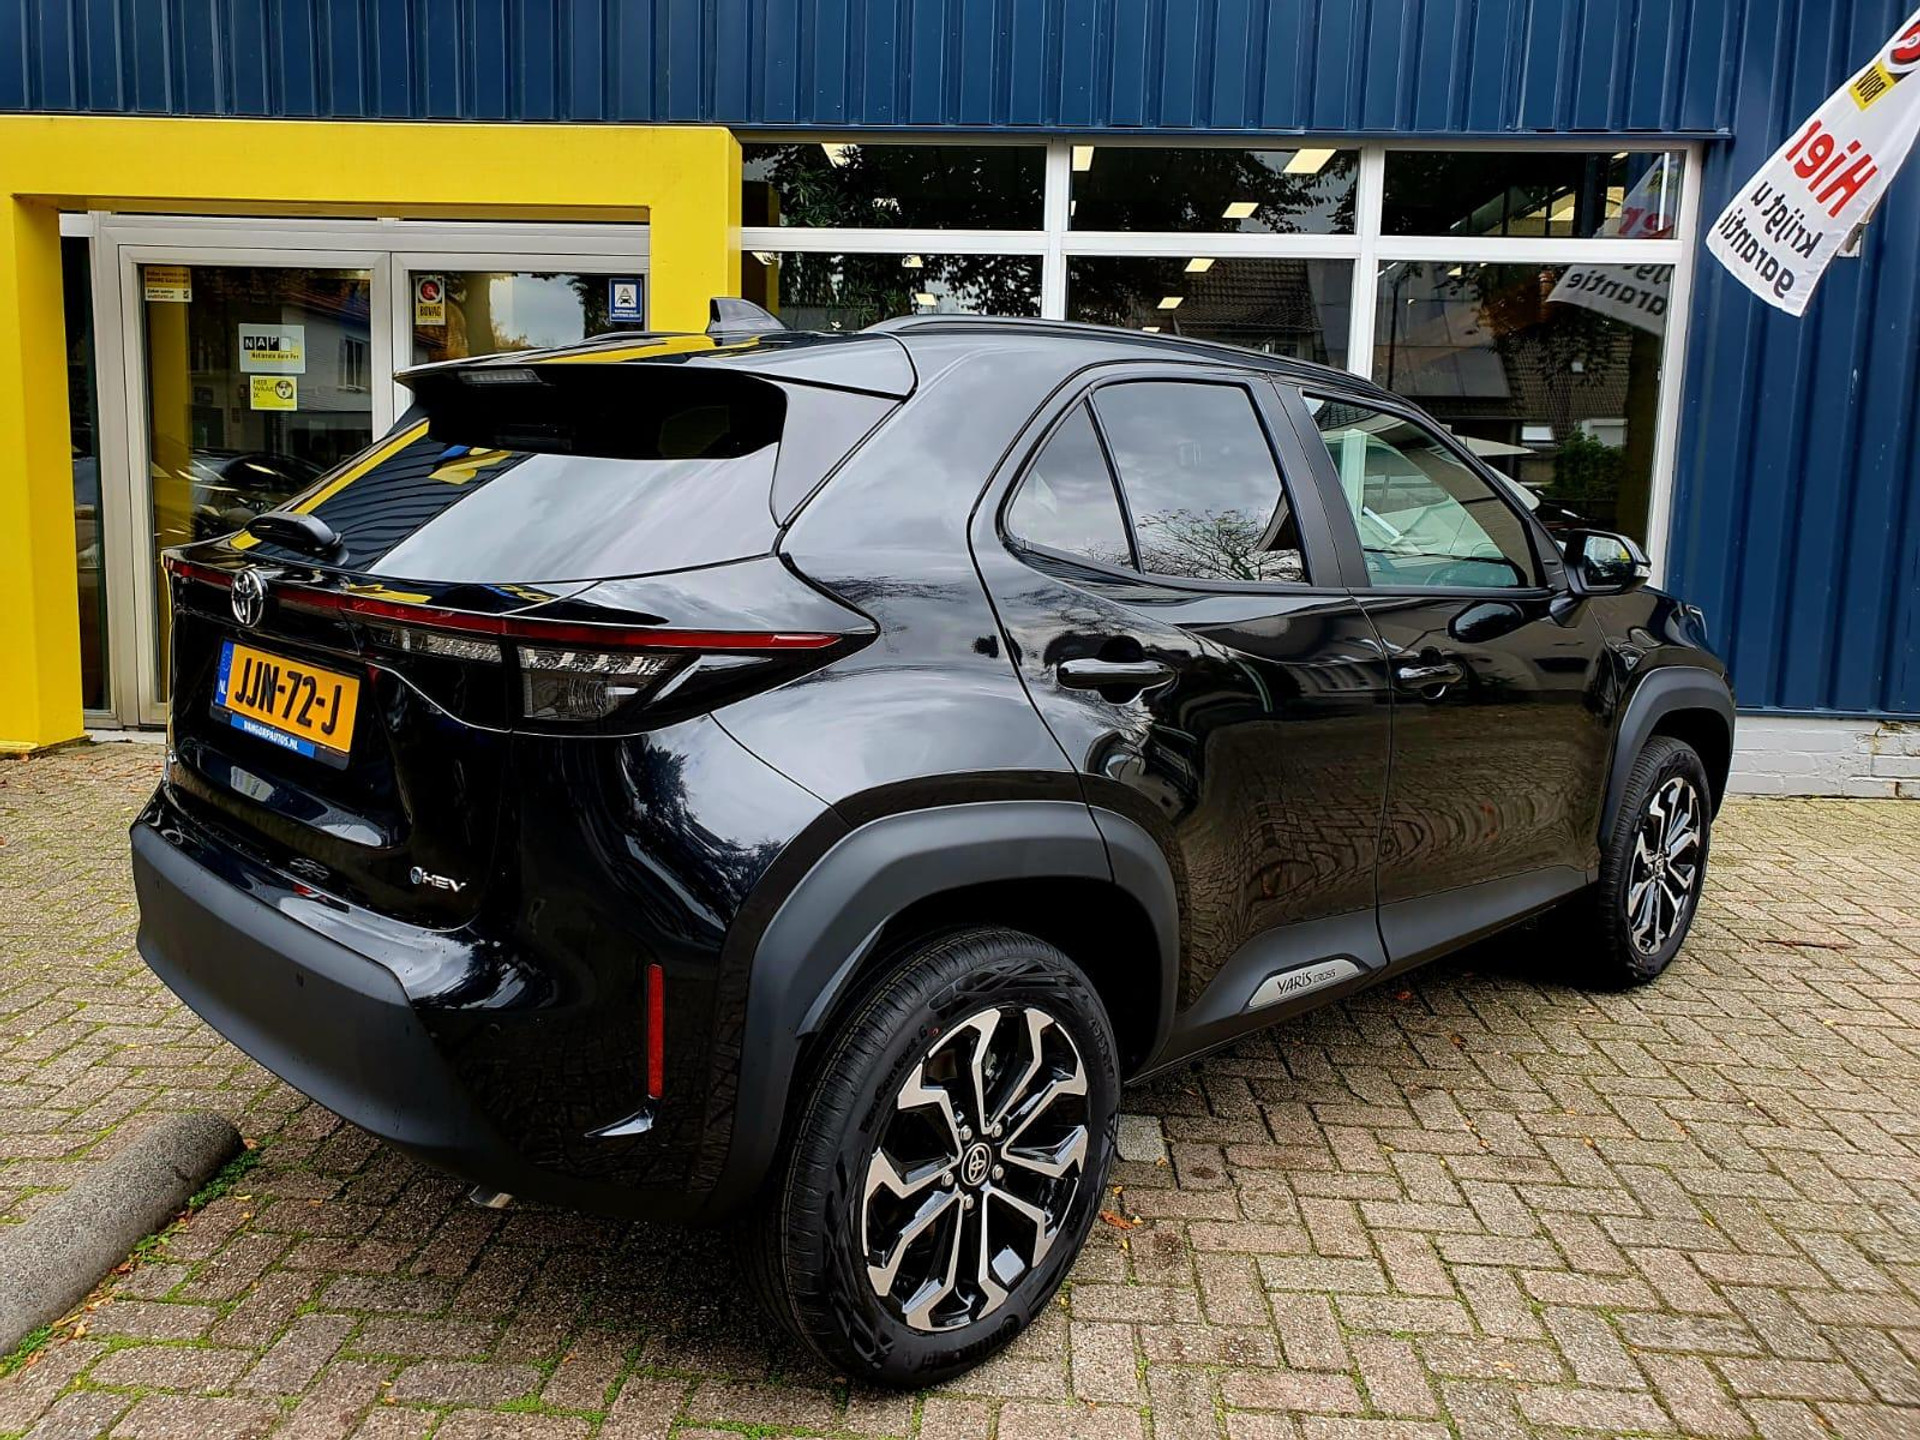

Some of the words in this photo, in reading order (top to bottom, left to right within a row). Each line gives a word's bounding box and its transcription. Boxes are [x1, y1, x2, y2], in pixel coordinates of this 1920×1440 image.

[419, 305, 442, 317] BOVAG
[218, 680, 227, 695] NL
[234, 658, 342, 735] JJN-72-J
[422, 872, 467, 892] HEV
[1313, 968, 1336, 983] CROSS
